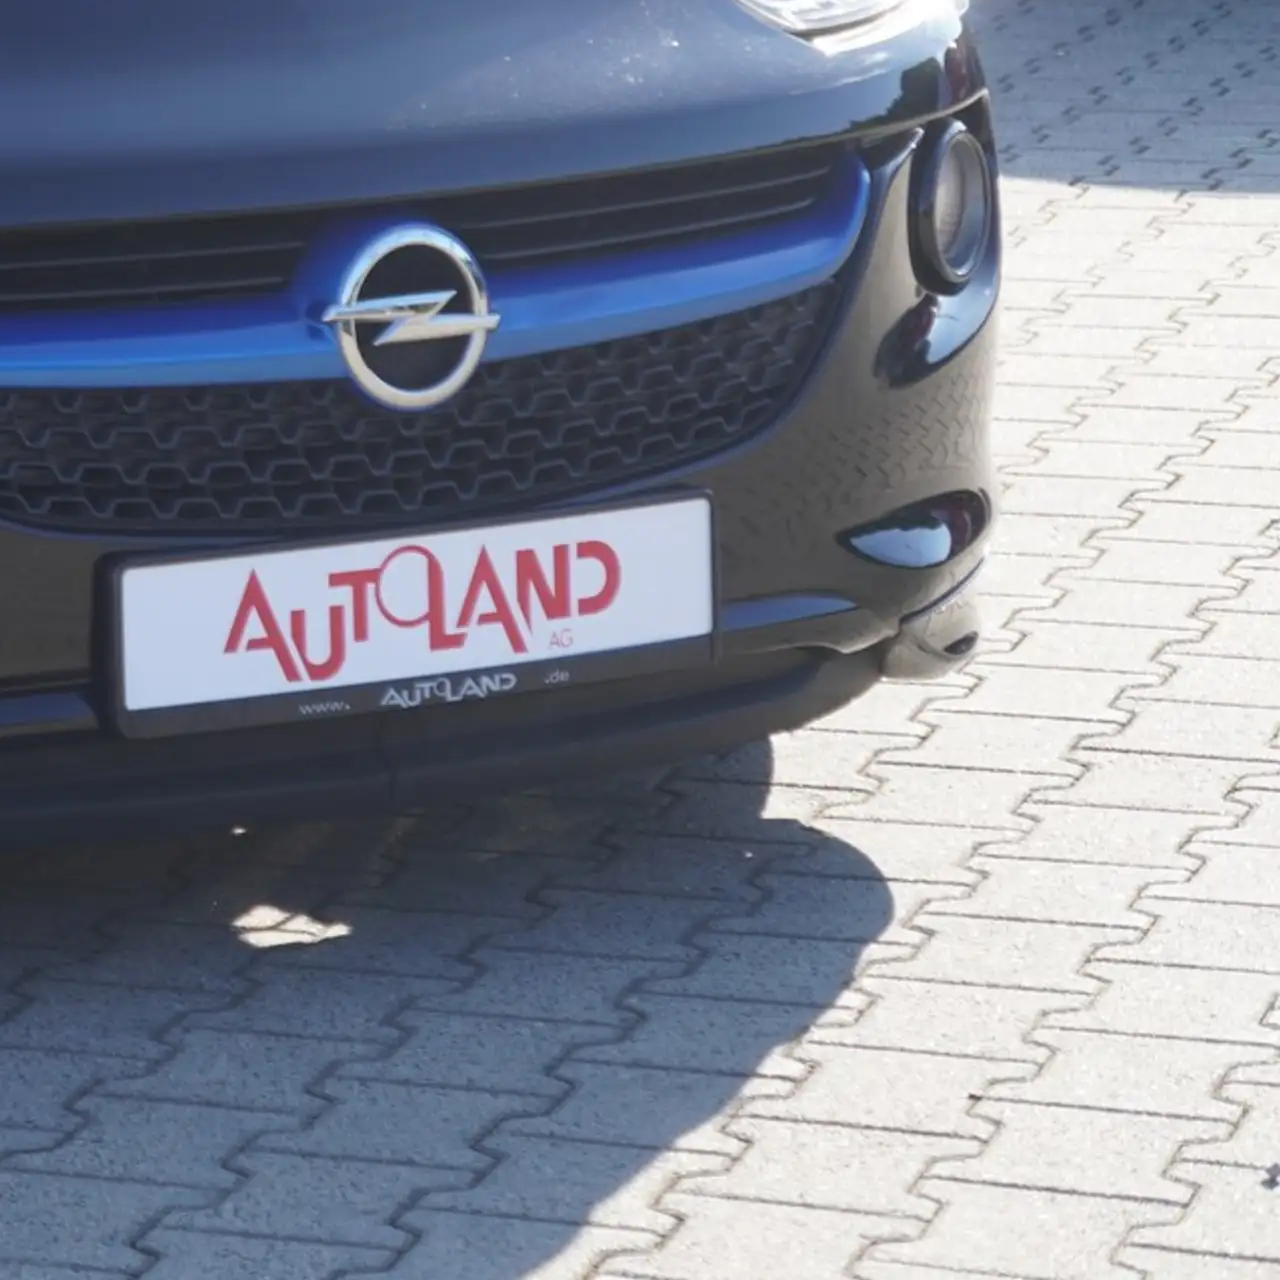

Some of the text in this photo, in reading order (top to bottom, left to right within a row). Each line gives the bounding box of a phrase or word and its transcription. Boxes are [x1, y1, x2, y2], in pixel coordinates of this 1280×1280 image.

[223, 540, 621, 683] AUTOLAND
[548, 628, 574, 649] AG
[299, 668, 570, 716] www. AUTOLAND .de
